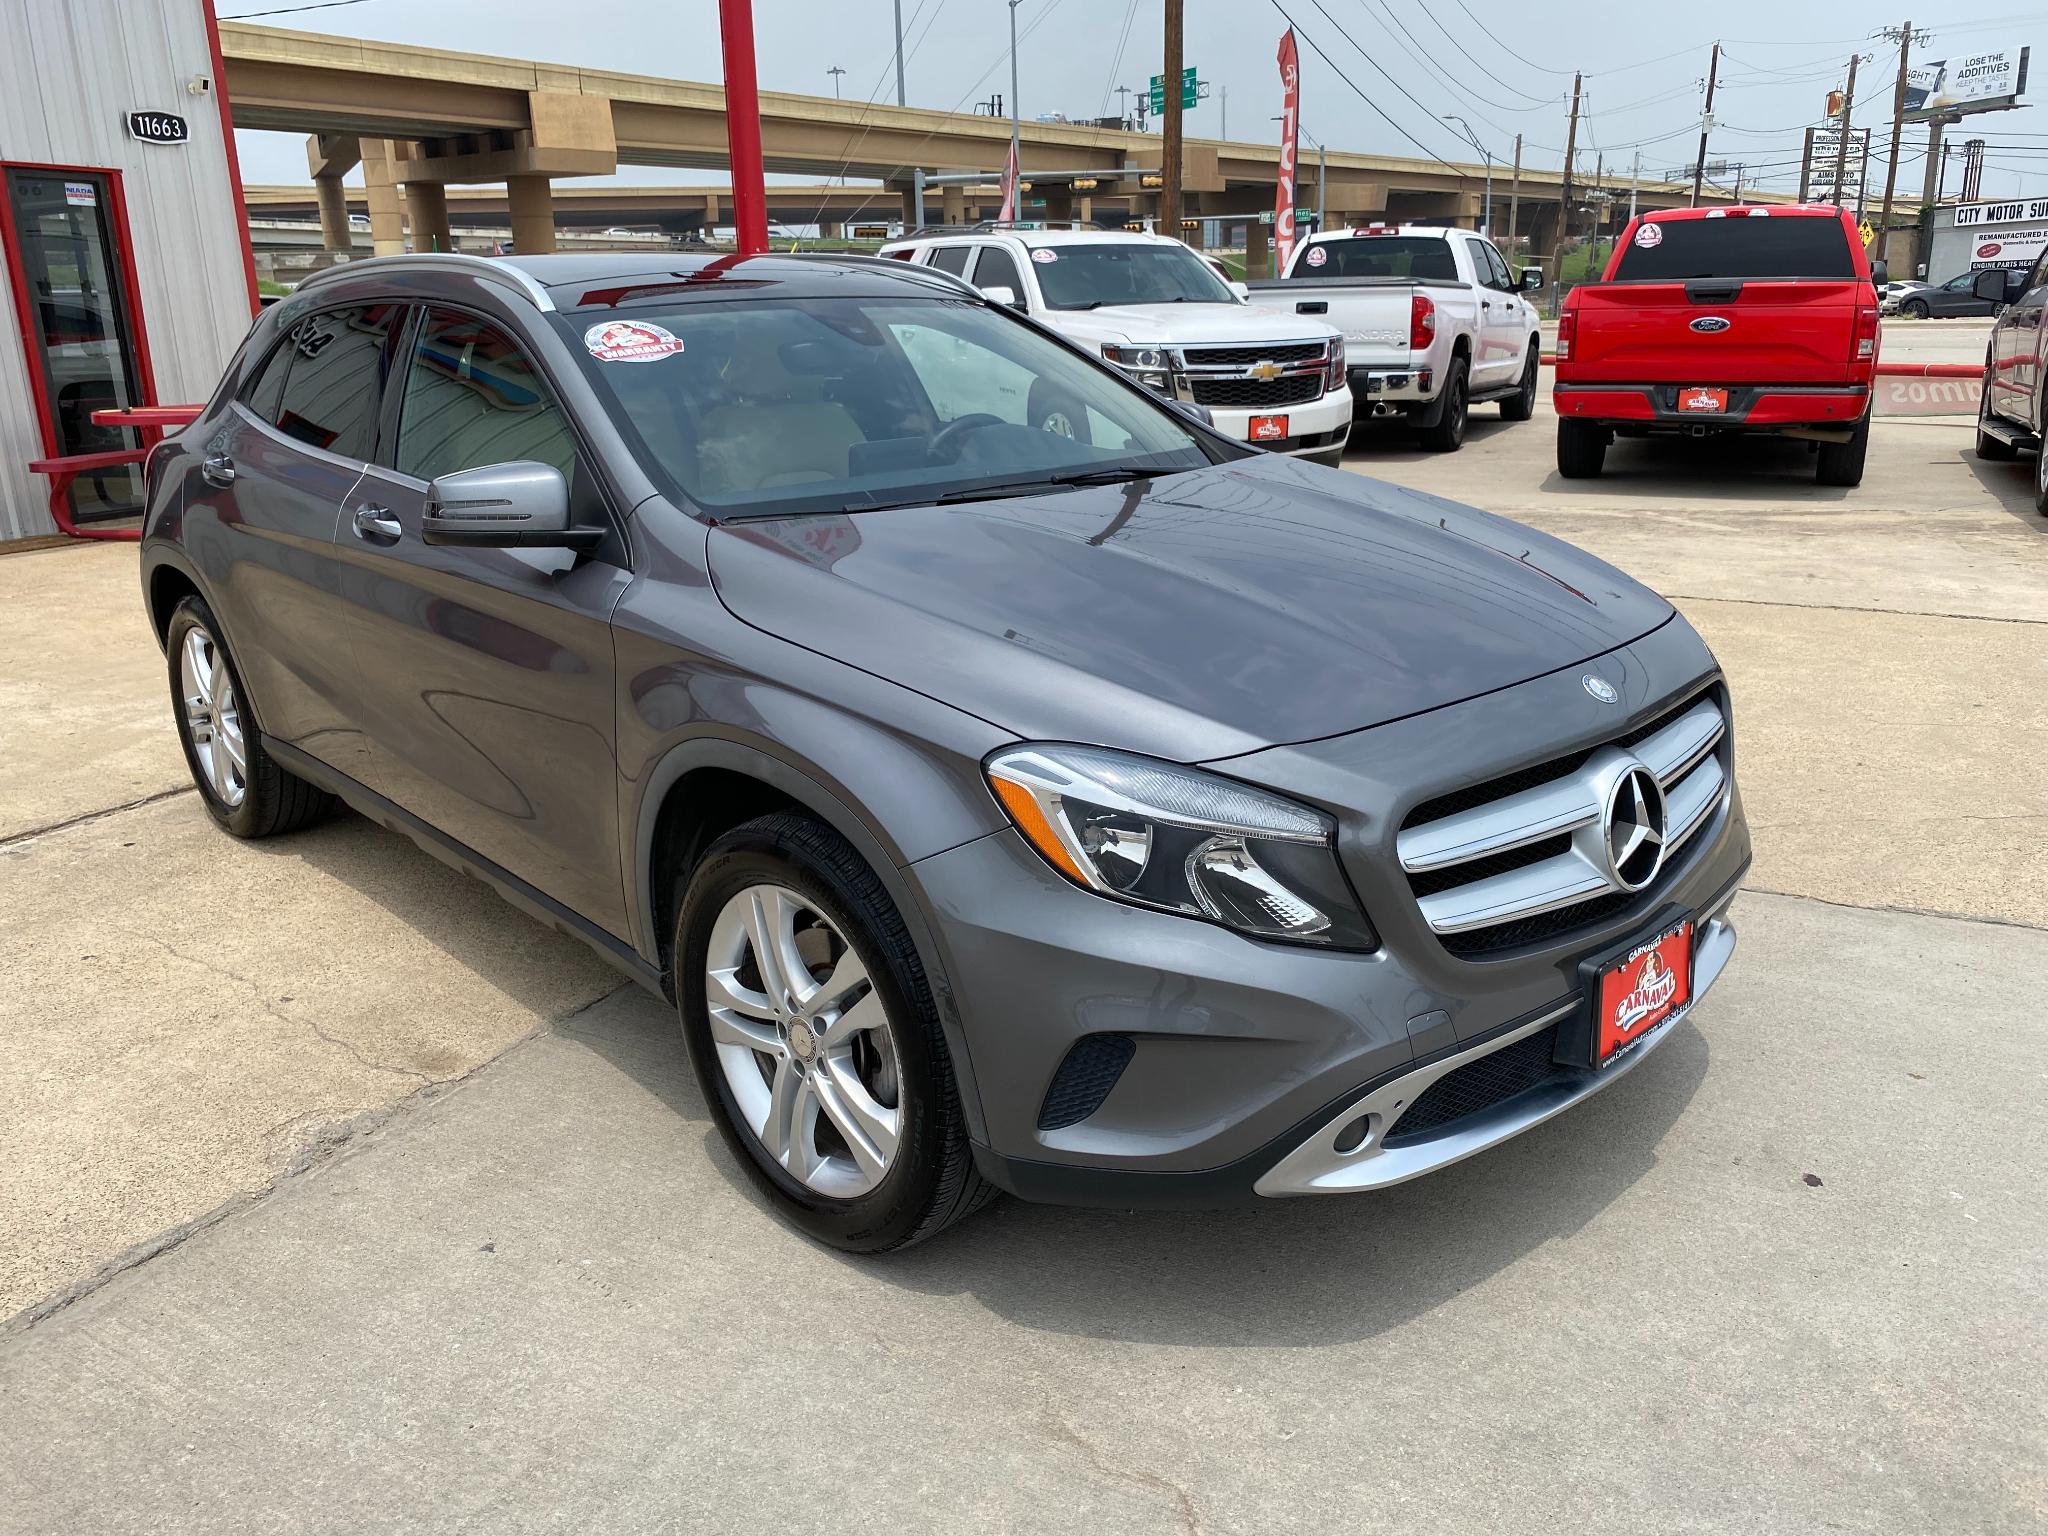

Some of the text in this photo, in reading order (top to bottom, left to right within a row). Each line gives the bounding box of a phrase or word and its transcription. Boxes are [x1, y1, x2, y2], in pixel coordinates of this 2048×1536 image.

[1965, 53, 2004, 67] LOSE THE
[1957, 62, 2010, 79] ADDITIVES
[138, 116, 181, 137] 11663
[1957, 207, 1981, 223] CITY
[1986, 204, 2024, 221] MOTOR
[1978, 231, 2042, 240] REMANUFACTURED
[1699, 319, 1721, 329] Ford
[604, 344, 675, 359] WARRANTY
[1628, 935, 1662, 963] CARNAVAL
[1615, 974, 1674, 1022] CARNAVAL
